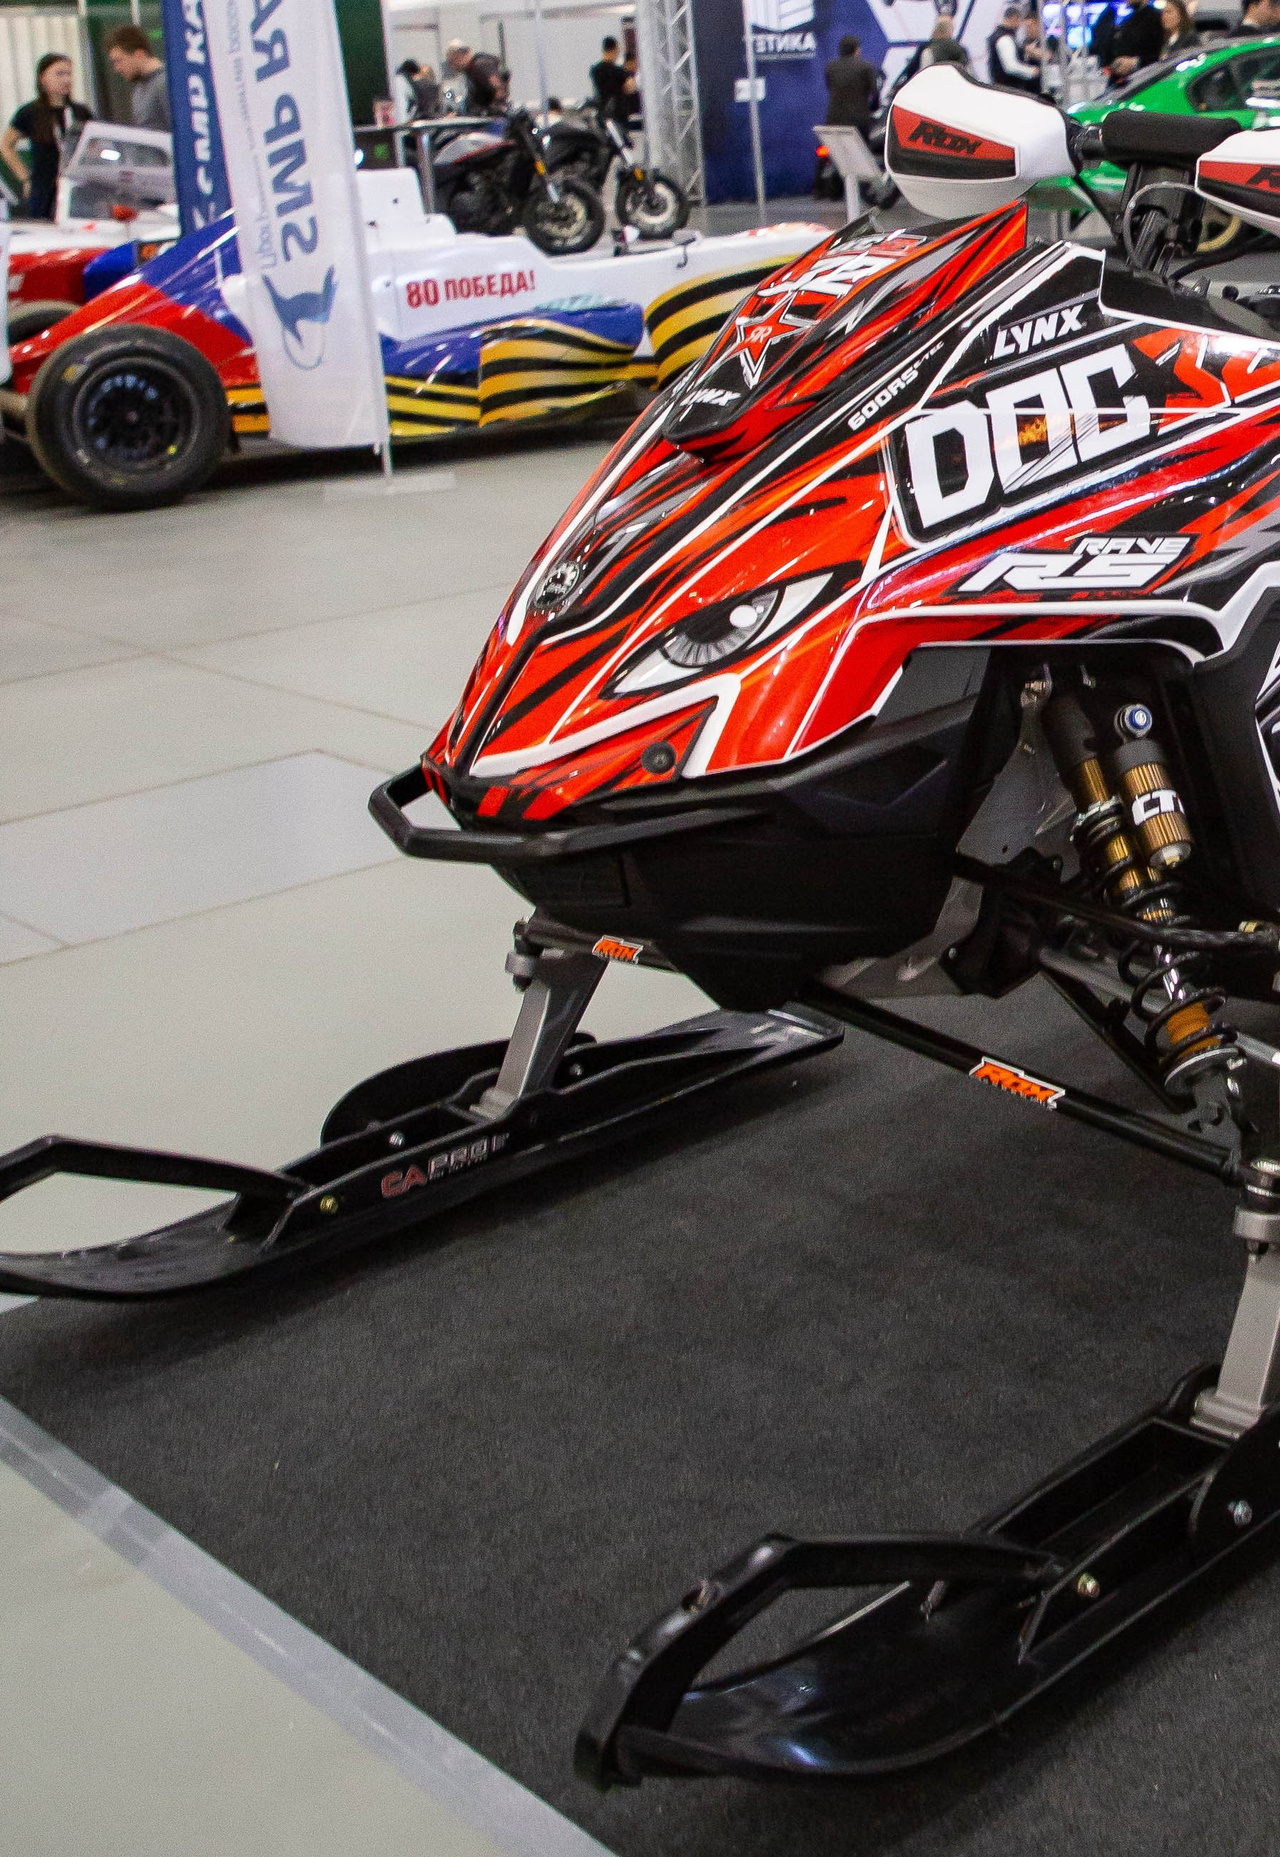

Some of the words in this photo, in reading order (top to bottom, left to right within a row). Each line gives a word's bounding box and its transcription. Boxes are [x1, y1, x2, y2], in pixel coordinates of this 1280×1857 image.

[908, 120, 983, 156] ROX
[406, 278, 440, 309] 80
[444, 270, 536, 301] ПОБЕДА!
[993, 302, 1085, 360] LYNX
[905, 343, 1151, 529] DOC
[1072, 536, 1182, 556] RAVE
